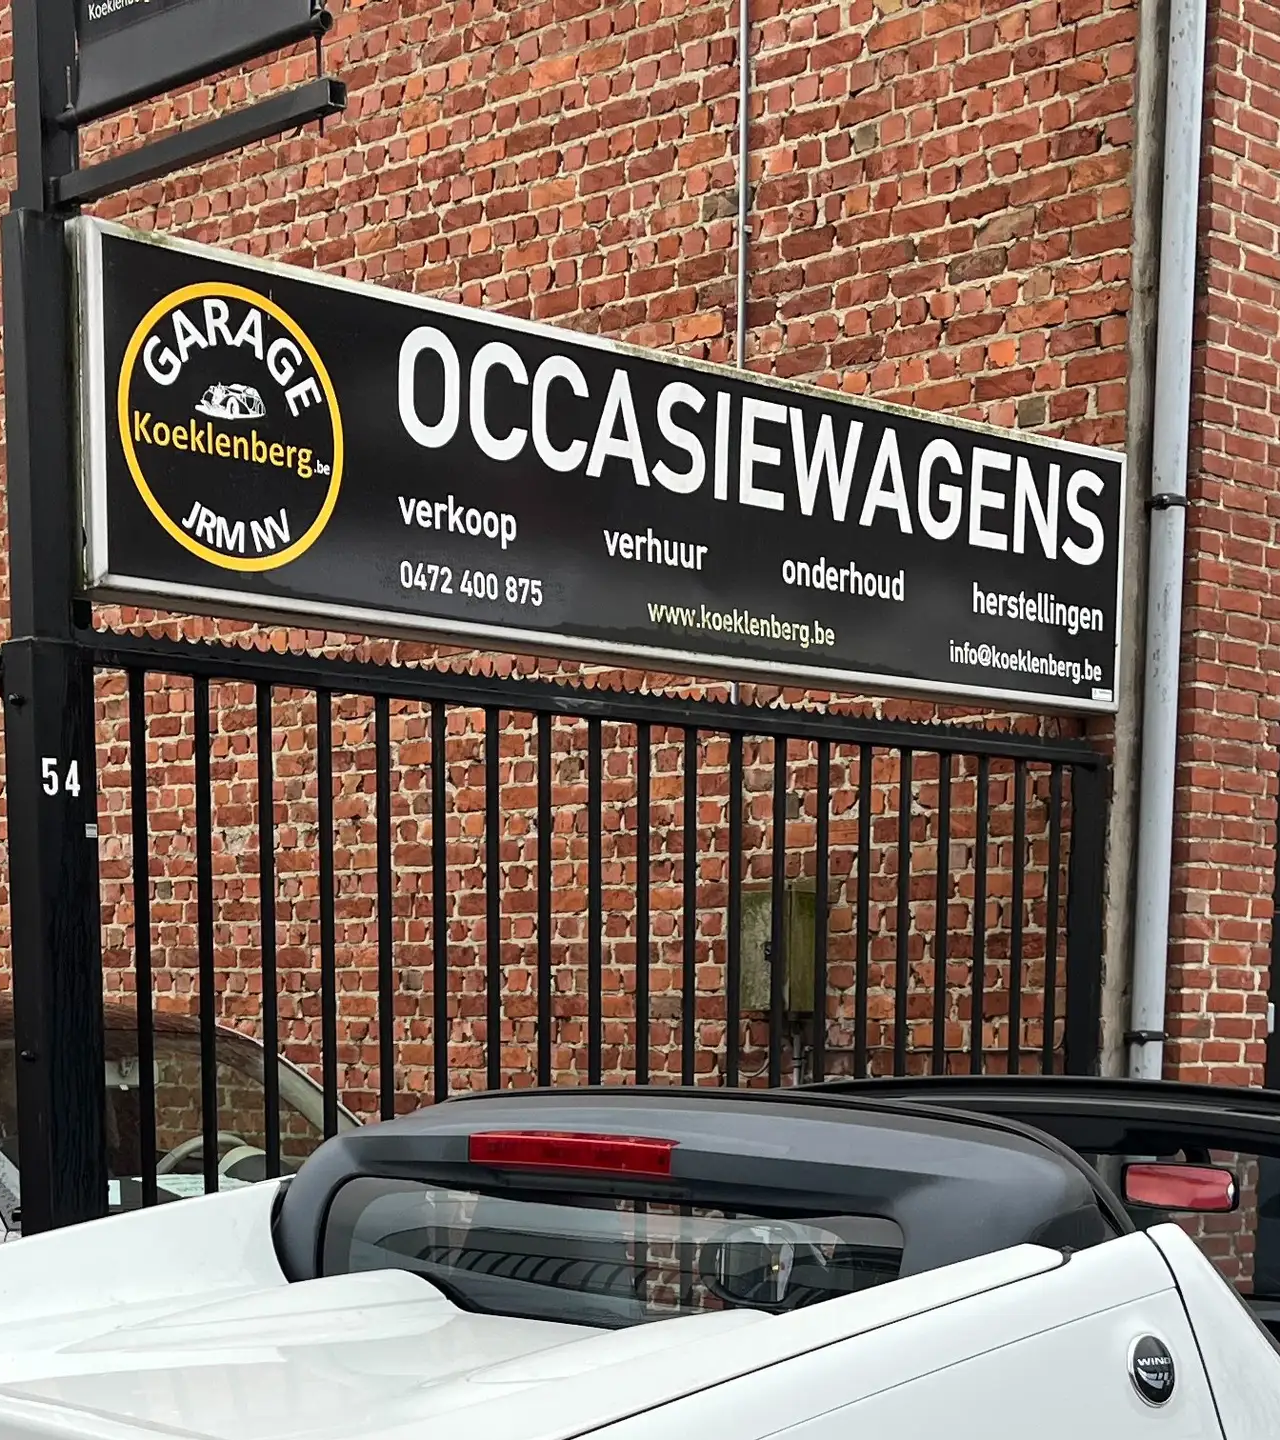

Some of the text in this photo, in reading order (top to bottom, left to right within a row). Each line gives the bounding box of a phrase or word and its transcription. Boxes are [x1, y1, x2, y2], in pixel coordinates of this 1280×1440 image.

[143, 299, 322, 417] GARAGE
[399, 326, 1105, 565] OCCASIEWAGENS
[181, 501, 290, 553] JRM NV
[398, 495, 1103, 635] verkoop verhuur onderhoud herstellingen
[400, 560, 543, 606] 0472 400 875
[648, 602, 835, 648] www.koeklenberg.be
[949, 640, 1102, 684] info@koeklenberg.be
[42, 757, 80, 797] 54
[1137, 1356, 1171, 1366] WIND
